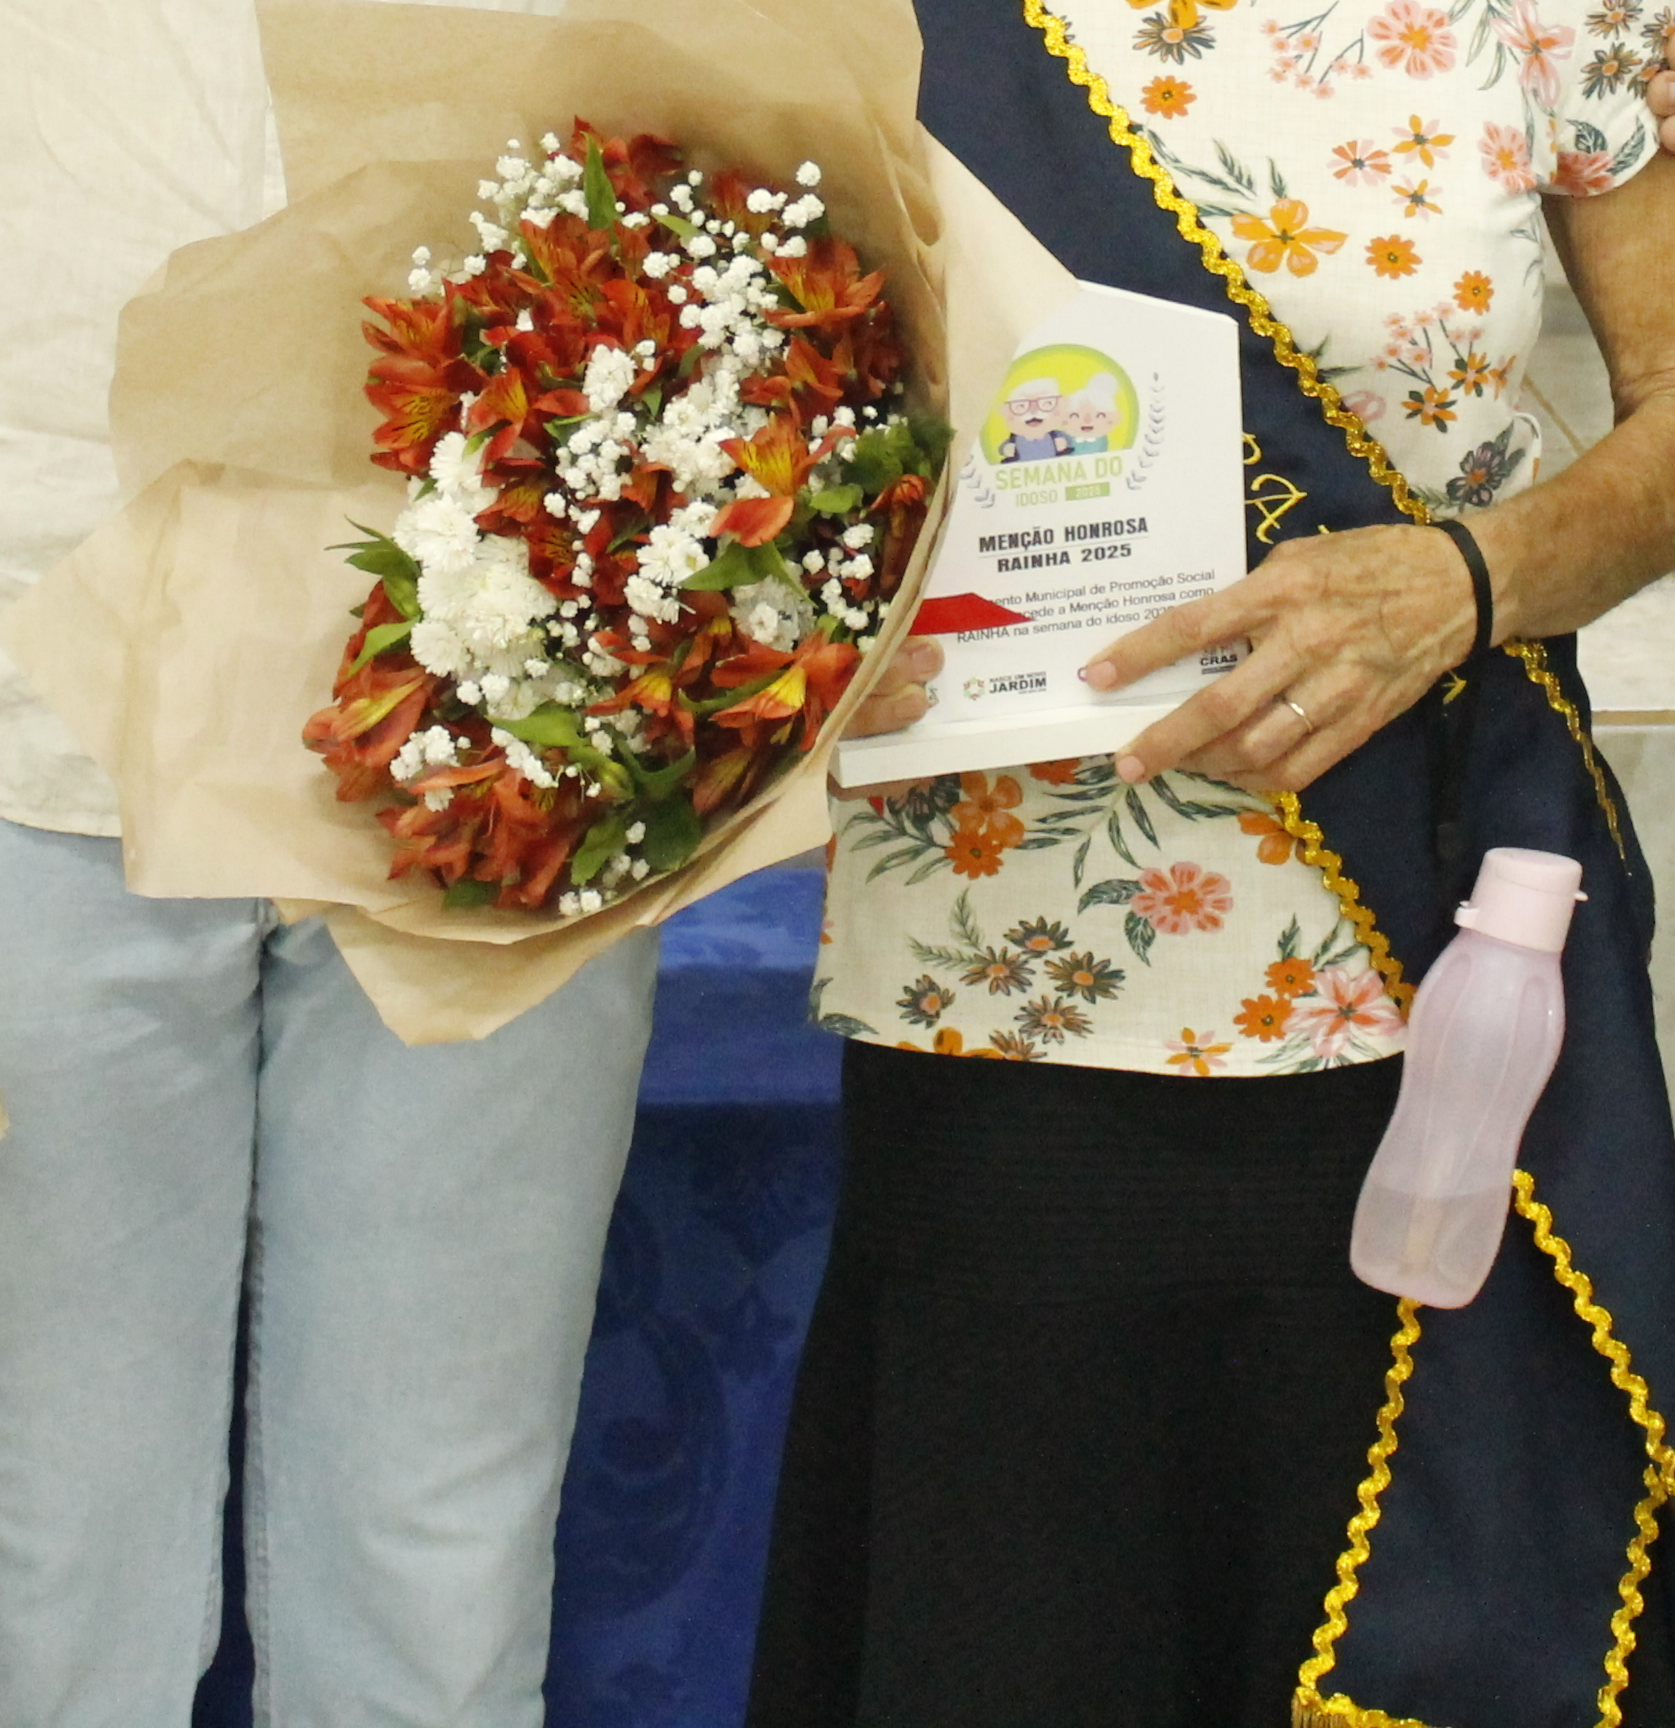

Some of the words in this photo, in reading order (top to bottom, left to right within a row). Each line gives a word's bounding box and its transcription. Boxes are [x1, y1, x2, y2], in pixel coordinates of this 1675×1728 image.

[995, 459, 1087, 490] SEMANA
[1095, 456, 1123, 477] DO
[1016, 490, 1058, 507] IDOSO
[979, 527, 1054, 553] MENÇÃO
[1065, 517, 1149, 542] HONROSA
[997, 551, 1071, 573] RAINHA
[1081, 543, 1132, 563] 2025
[1025, 585, 1087, 606] Municipal
[1089, 581, 1106, 595] de
[1110, 574, 1174, 593] Promoção
[1177, 569, 1216, 584] Social
[1058, 605, 1066, 615] a
[1070, 596, 1120, 615] Menção
[1123, 591, 1176, 607] Honrosa
[957, 627, 1010, 644] RAINHA
[1013, 625, 1029, 637] na
[1033, 618, 1082, 634] semana
[1086, 612, 1102, 627] do
[1106, 606, 1140, 624] idoso
[989, 677, 1046, 693] JARDIM
